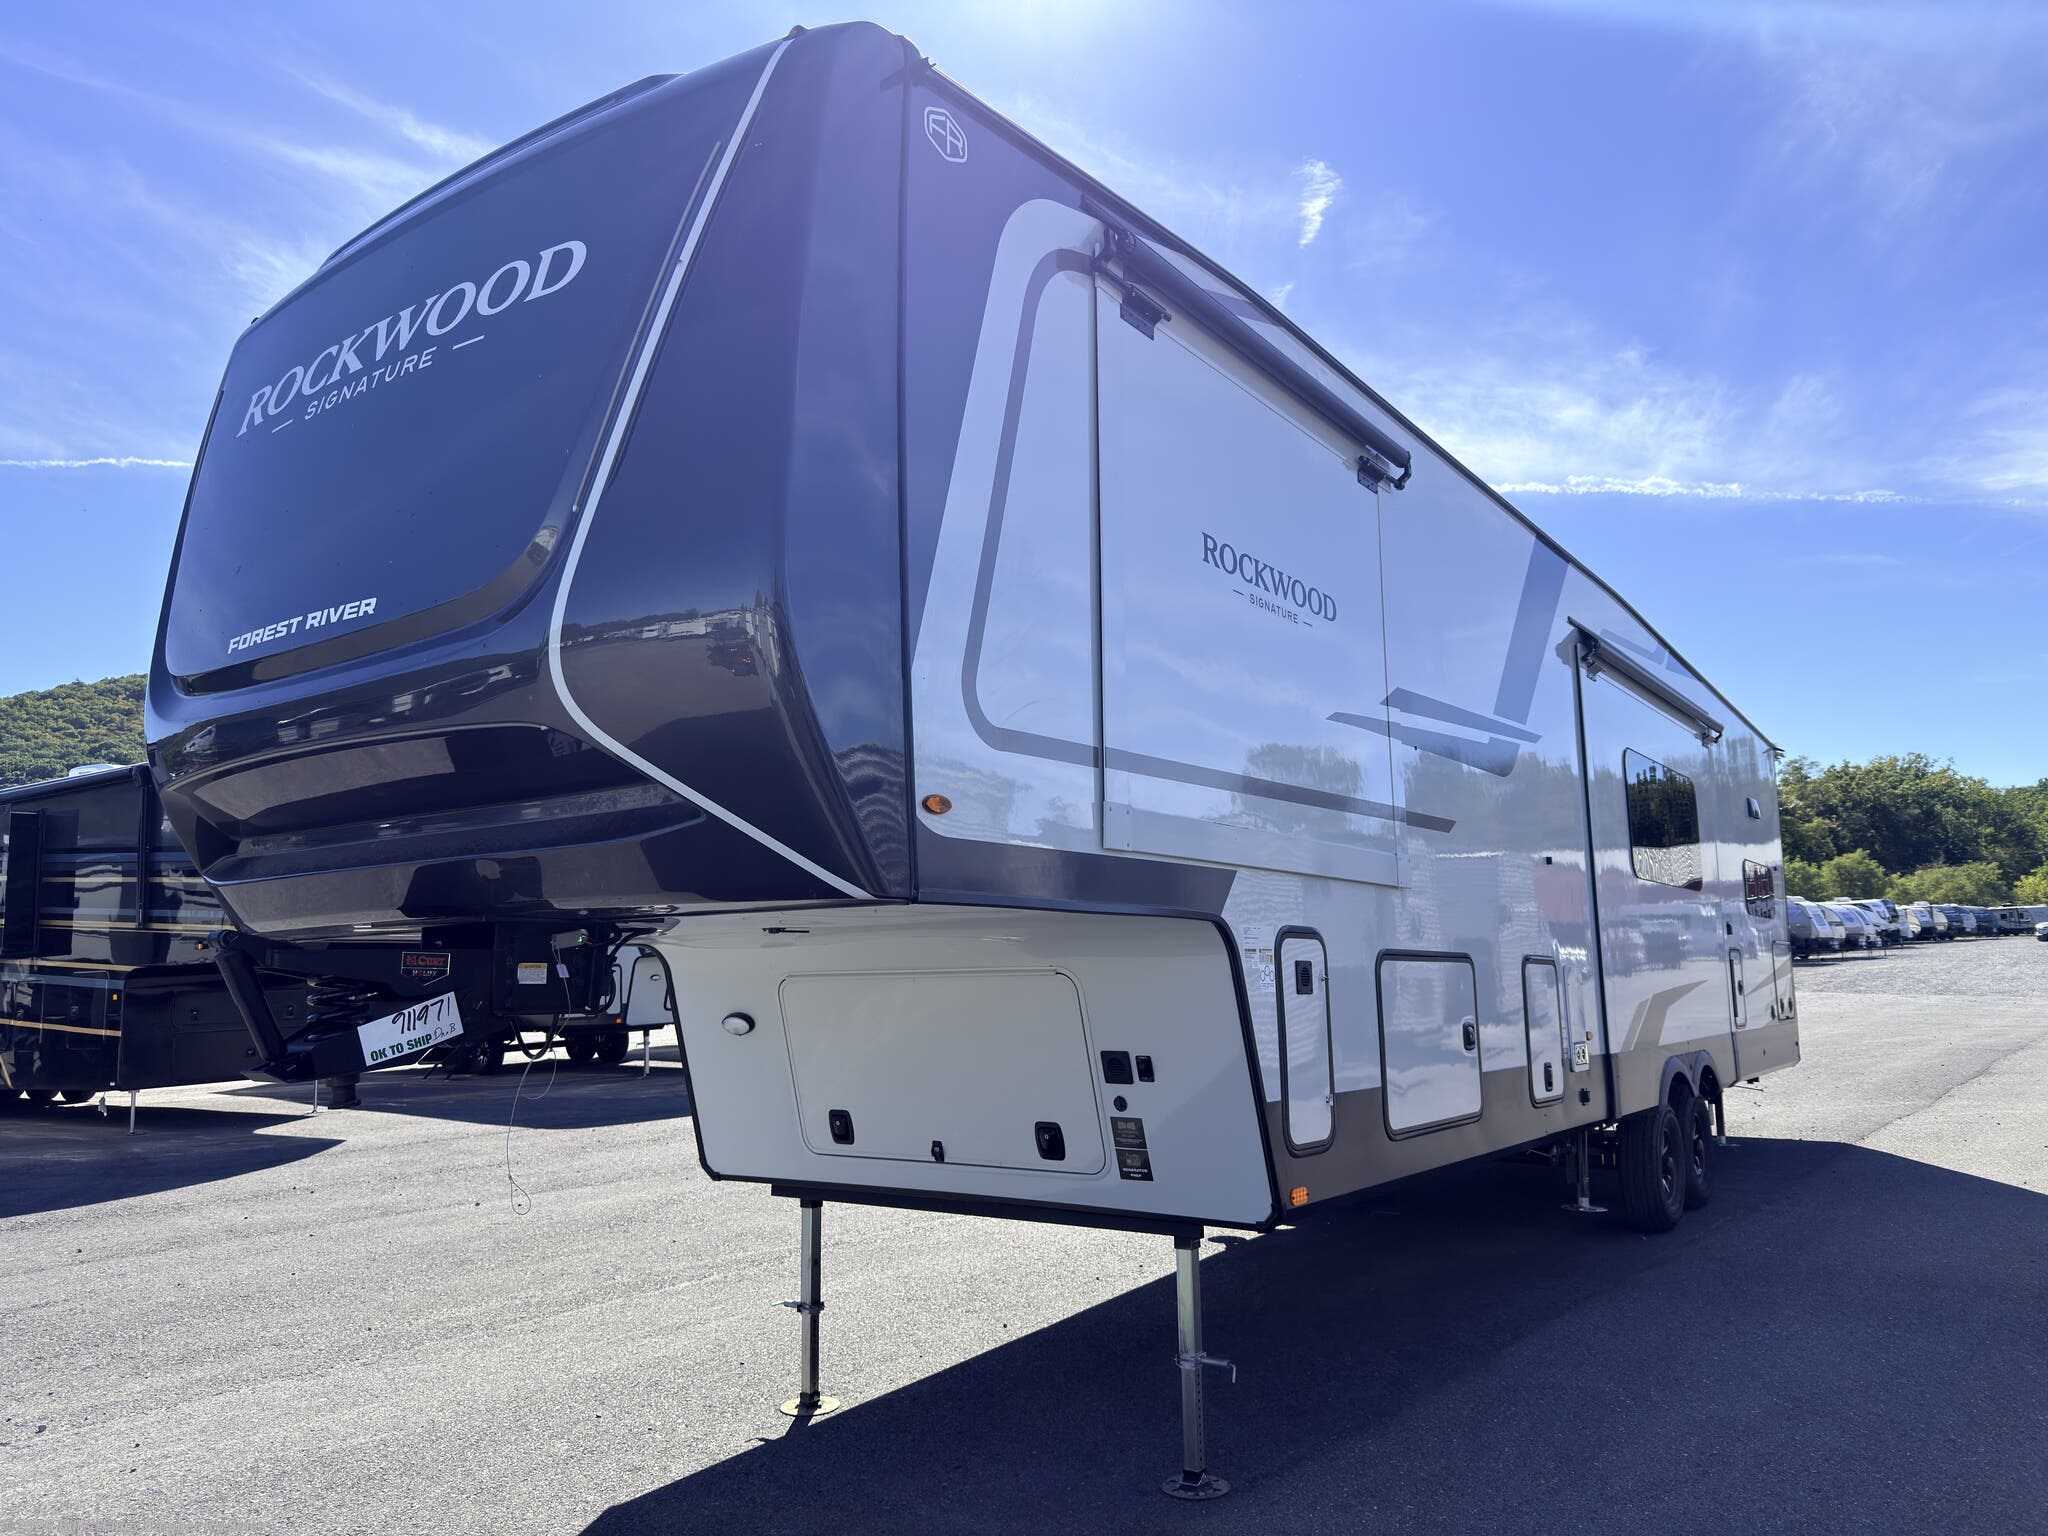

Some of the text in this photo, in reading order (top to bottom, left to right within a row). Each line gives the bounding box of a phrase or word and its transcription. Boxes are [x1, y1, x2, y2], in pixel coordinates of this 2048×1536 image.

[236, 240, 587, 439] ROCKWOOD
[304, 346, 437, 420] SIGNATURE
[1202, 531, 1337, 622] ROCKWOOD
[227, 597, 377, 654] FOREST RIVER
[1249, 593, 1298, 624] SIGNATURE
[391, 996, 450, 1034] 911971
[370, 1033, 432, 1061] OK TO SHIP
